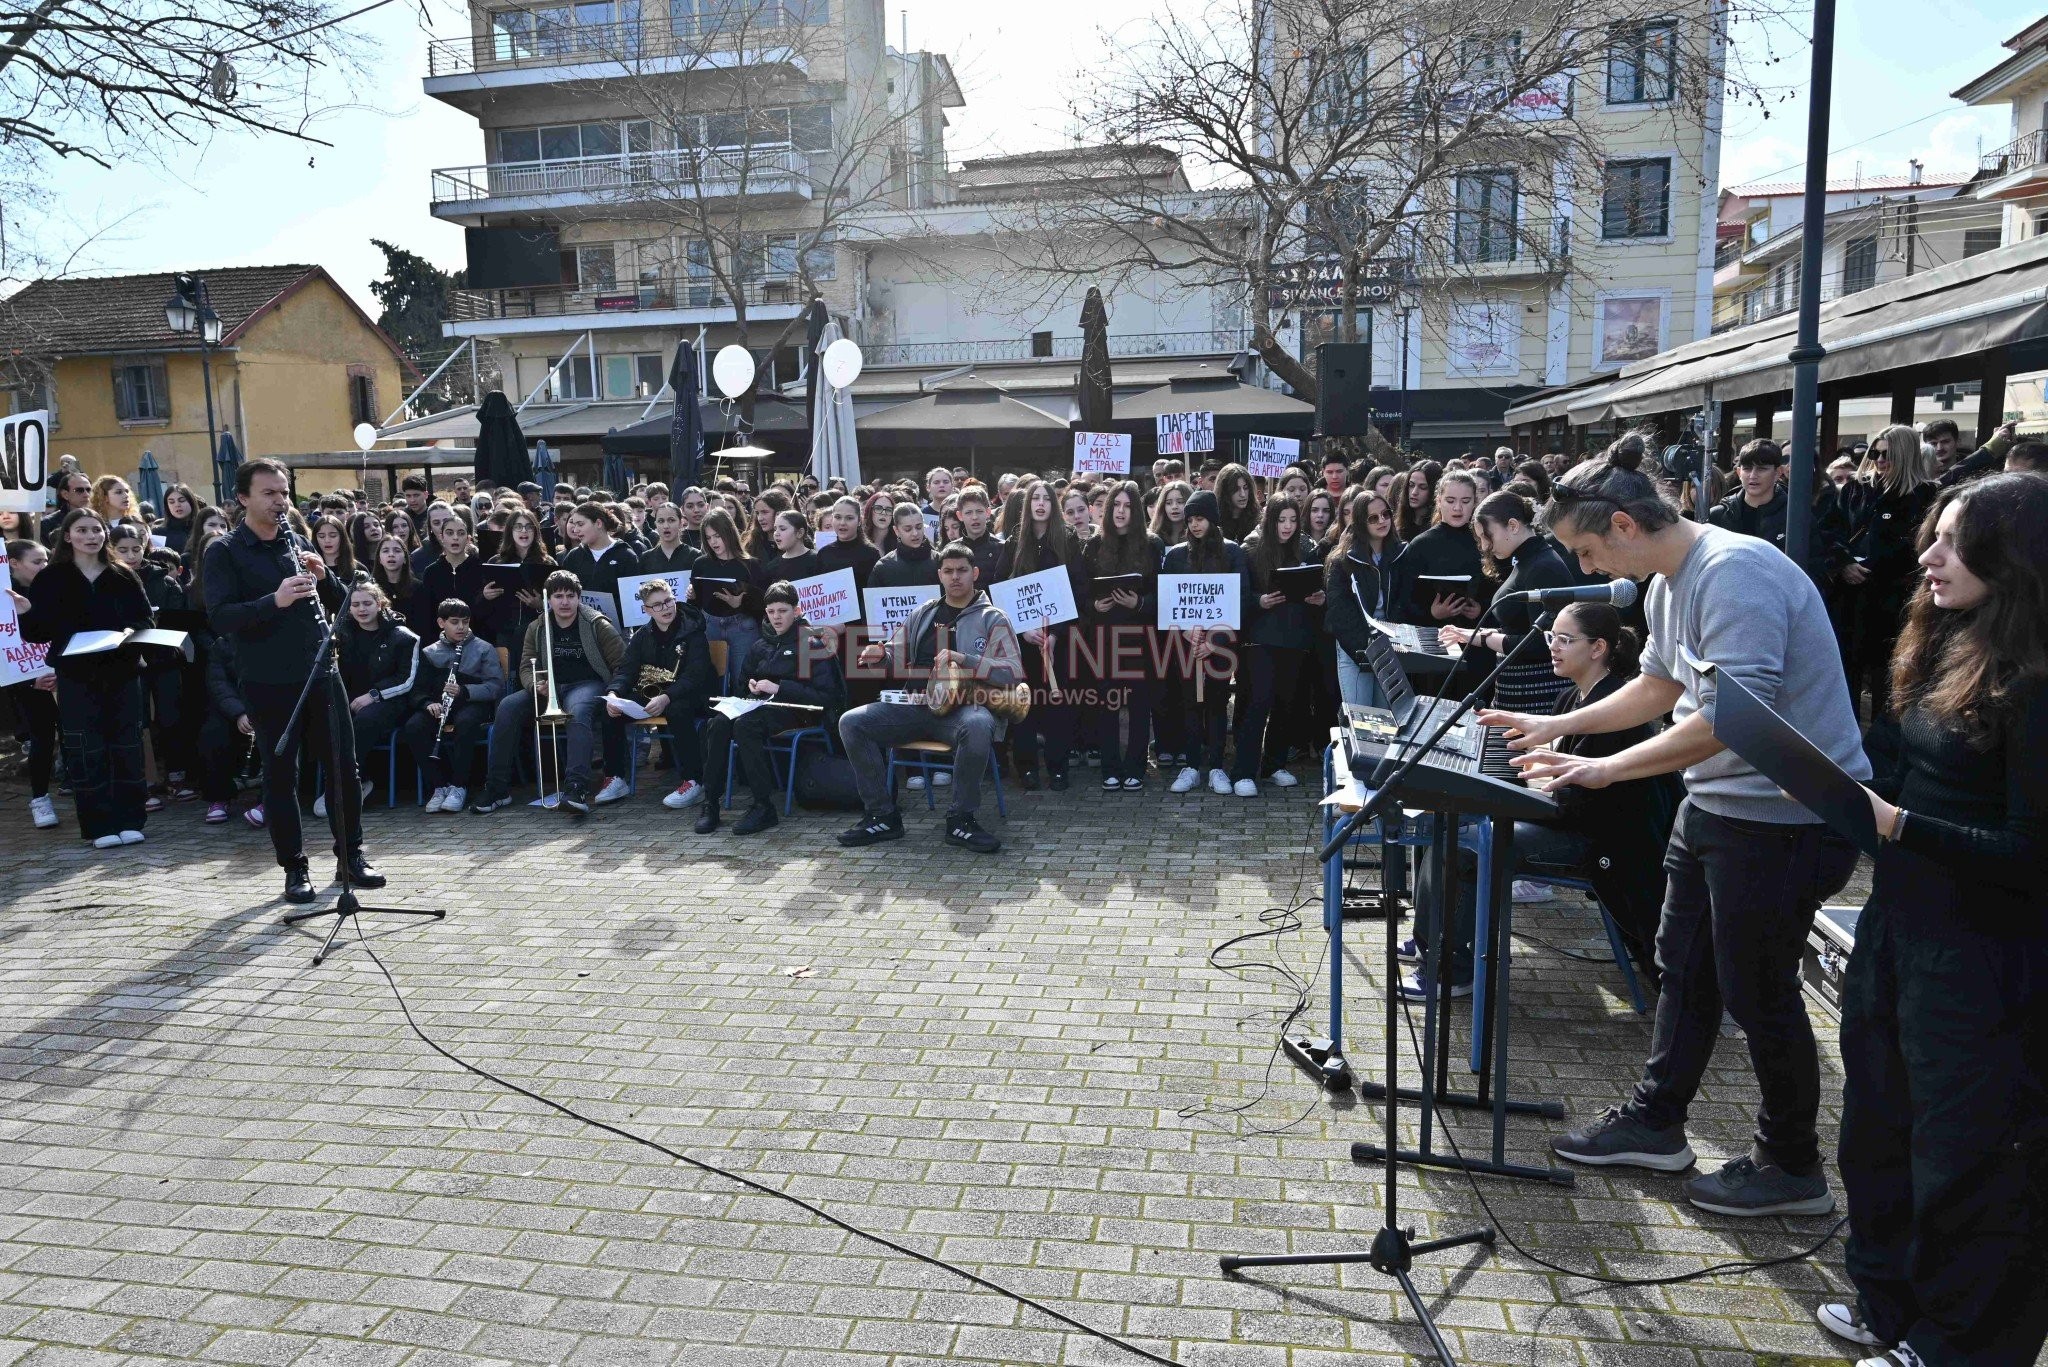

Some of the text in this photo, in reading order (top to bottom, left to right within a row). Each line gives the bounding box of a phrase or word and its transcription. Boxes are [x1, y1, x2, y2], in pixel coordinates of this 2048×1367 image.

[1162, 411, 1211, 434] ΠΑΡΕ ΜΕ
[1077, 432, 1122, 447] ΟΙ ΖΩΕΣ
[1250, 435, 1276, 450] ΜΑΜΑ
[1089, 447, 1112, 460] ΜΑΣ
[798, 583, 824, 599] ΝΙΚΟΣ
[1017, 582, 1044, 598] ΜΑΡΙΑ
[1177, 582, 1225, 595] ΙΦΙΓΕΝΕΙΑ
[882, 595, 918, 608] ΝΤΕΝΙΣ
[1016, 593, 1042, 610] ΕΓΟΥΤ
[1178, 595, 1216, 606] ΜΗΤΣΚΑ
[807, 605, 841, 621] ΤΩΝ 27
[1017, 602, 1058, 622] ΕΤΩΝ 55
[1172, 607, 1223, 620] ΕΤΩΝ 23
